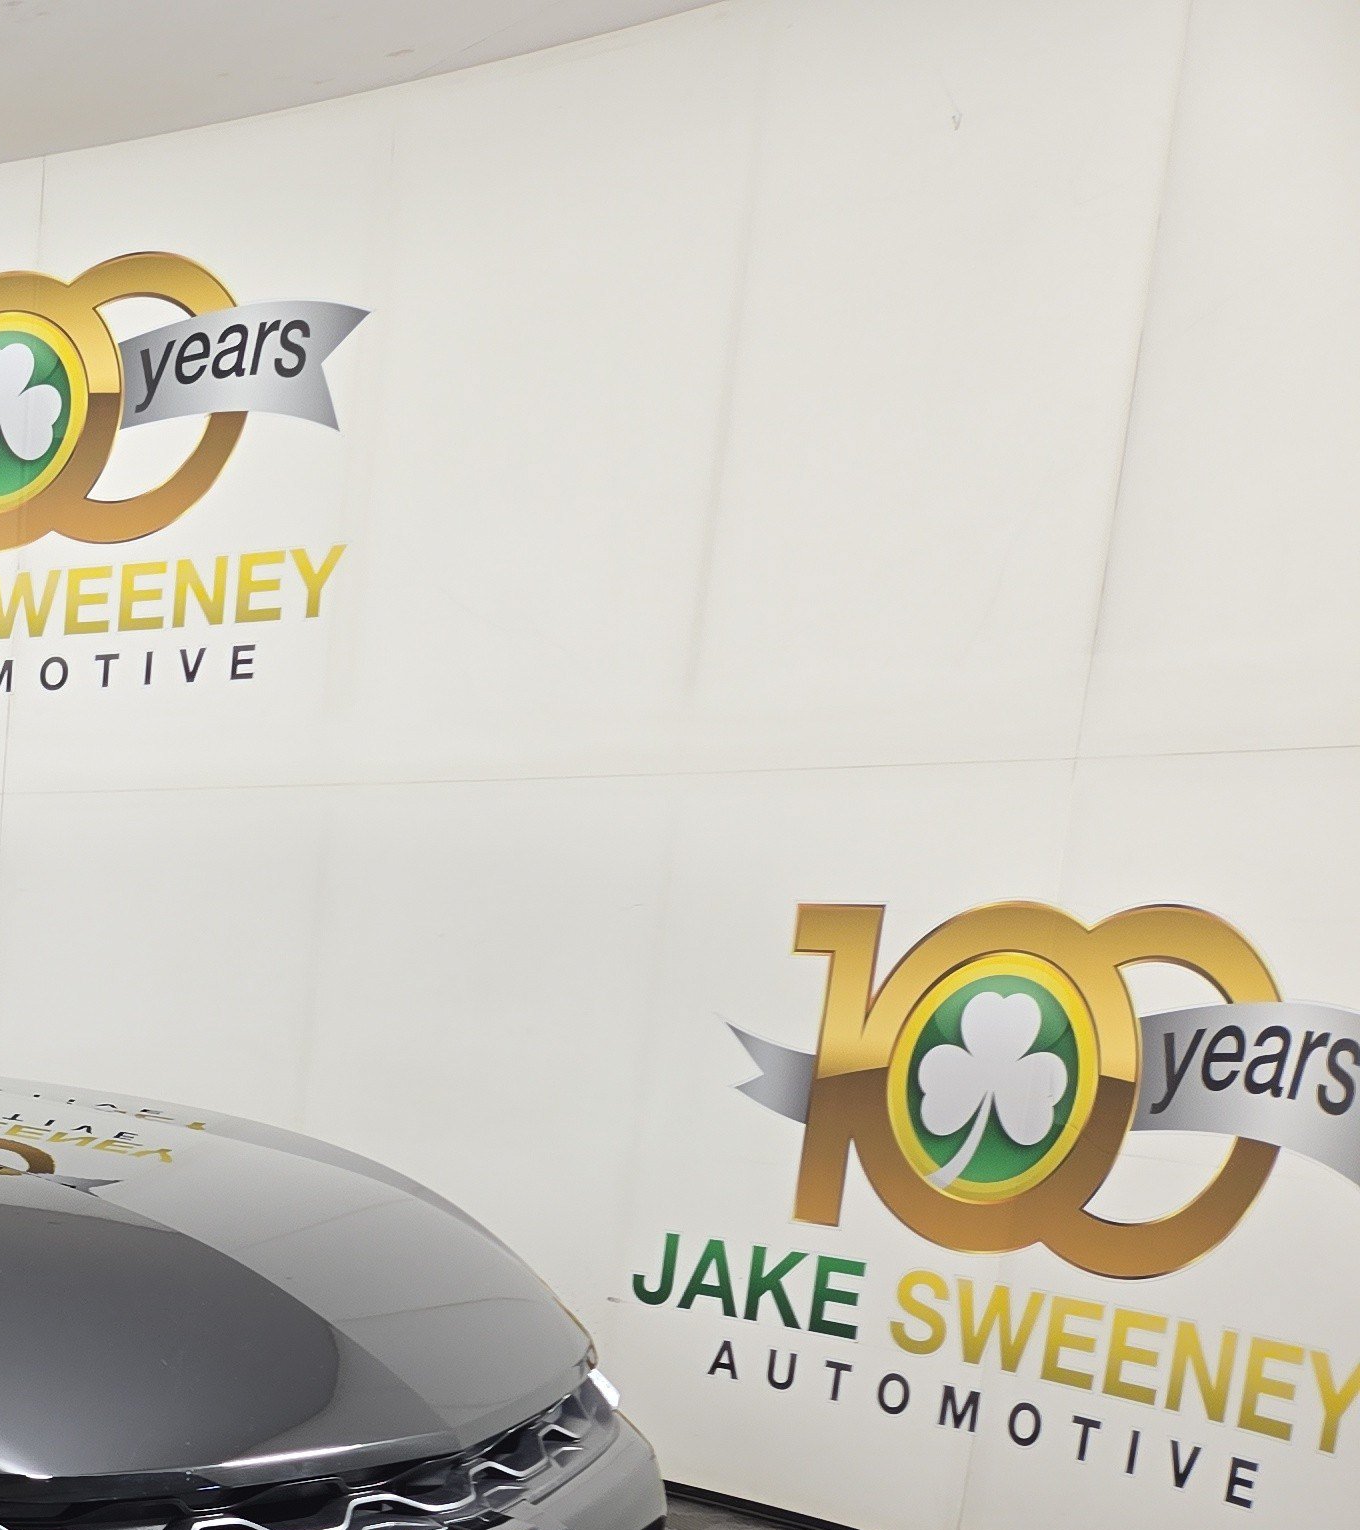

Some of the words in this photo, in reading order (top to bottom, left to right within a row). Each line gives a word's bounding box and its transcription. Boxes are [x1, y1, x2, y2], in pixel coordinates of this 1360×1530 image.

[133, 316, 311, 413] years
[792, 901, 1282, 1280] 100
[1149, 1024, 1360, 1117] years
[632, 1233, 867, 1341] JAKE
[888, 1270, 1360, 1455] SWEENEY
[707, 1340, 1261, 1510] AUTOMOTIVE
